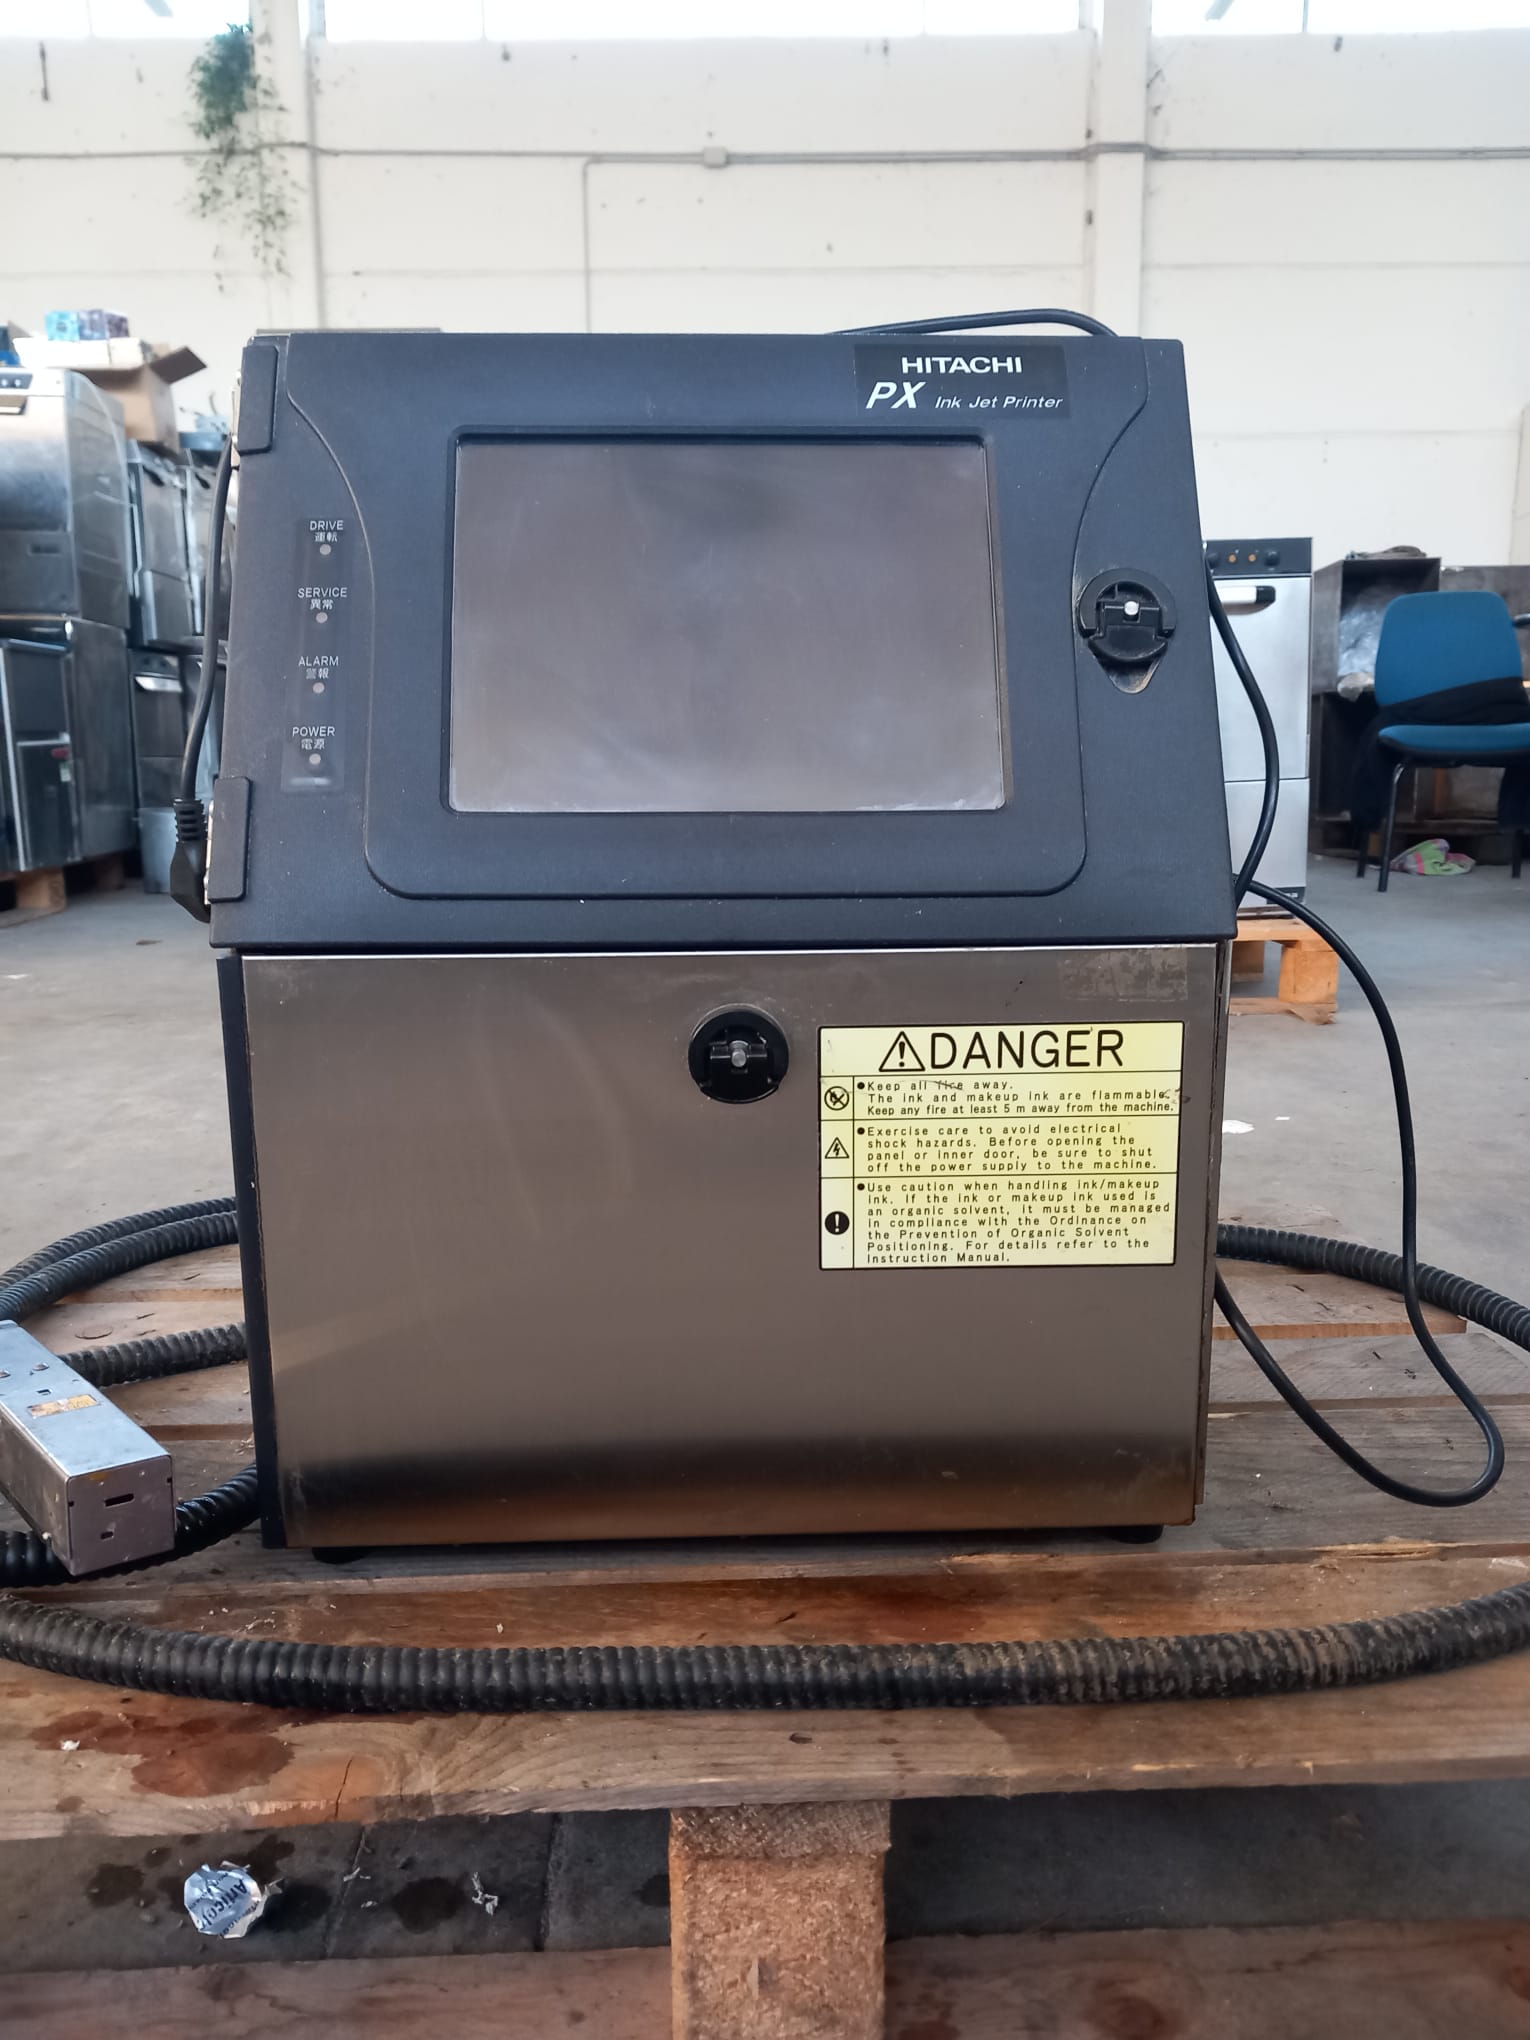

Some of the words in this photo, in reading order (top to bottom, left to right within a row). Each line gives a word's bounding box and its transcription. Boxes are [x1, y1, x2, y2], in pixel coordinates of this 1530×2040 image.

[901, 356, 1023, 374] HITACHI
[865, 381, 927, 409] PX
[935, 396, 962, 409] Ink
[969, 396, 998, 409] Jet
[1003, 396, 1064, 409] Printer
[309, 520, 344, 531] DRIVE
[297, 587, 348, 598] SERVICE
[298, 655, 339, 667] ALARM
[292, 726, 335, 737] POWER
[930, 1029, 1125, 1070] DANGER
[867, 1081, 901, 1092] Keep
[911, 1080, 931, 1091] all
[974, 1081, 1013, 1091] away.
[868, 1093, 893, 1104] The
[903, 1093, 924, 1104] ink
[933, 1092, 957, 1103] and
[967, 1091, 1019, 1103] makeup
[1029, 1091, 1049, 1102] ink
[1059, 1093, 1082, 1101] are
[868, 1106, 895, 1117] Keep
[901, 1107, 921, 1117] any
[927, 1104, 947, 1115] fire
[953, 1105, 965, 1115] at
[970, 1104, 998, 1115] least
[1004, 1103, 1011, 1114] 5
[1016, 1106, 1026, 1114] m
[1032, 1105, 1061, 1114] away
[1067, 1103, 1094, 1113] from
[1099, 1102, 1118, 1113] the
[1124, 1101, 1174, 1112] machine.
[867, 1126, 929, 1137] Exercise
[938, 1128, 969, 1136] care
[979, 1126, 993, 1135] to
[1003, 1124, 1040, 1135] avoid
[1050, 1123, 1121, 1135] electrical
[868, 1138, 907, 1150] shock
[917, 1137, 977, 1149] hazards.
[989, 1136, 1038, 1148] Before
[1047, 1136, 1103, 1148] opening
[1113, 1135, 1135, 1146] the
[868, 1150, 905, 1162] panel
[914, 1152, 929, 1161] or
[938, 1149, 974, 1161] inner
[1033, 1148, 1048, 1159] be
[1058, 1150, 1088, 1158] sure
[1098, 1148, 1112, 1158] to
[1122, 1147, 1153, 1158] shut
[868, 1162, 889, 1173] off
[899, 1162, 921, 1173] the
[931, 1163, 973, 1173] power
[983, 1160, 1028, 1173] supply
[1038, 1161, 1052, 1171] to
[1062, 1160, 1084, 1170] the
[1094, 1159, 1157, 1170] machine.
[867, 1182, 892, 1193] Use
[901, 1181, 954, 1192] caution
[964, 1181, 998, 1192] when
[1008, 1180, 1068, 1192] handling
[1078, 1179, 1160, 1191] ink/makeup
[869, 1194, 894, 1205] ink.
[906, 1193, 916, 1205] If
[927, 1193, 949, 1204] the
[959, 1193, 979, 1204] ink
[988, 1195, 1002, 1203] or
[1012, 1192, 1064, 1204] makeup
[1074, 1192, 1094, 1202] ink
[1104, 1191, 1135, 1202] used
[1145, 1191, 1156, 1201] is
[868, 1209, 883, 1217] an
[892, 1205, 944, 1217] organic
[1023, 1204, 1033, 1215] it
[1043, 1204, 1076, 1215] must
[1086, 1203, 1101, 1214] be
[1110, 1202, 1170, 1214] managed
[869, 1218, 880, 1229] in
[890, 1217, 968, 1229] compliance
[978, 1216, 1008, 1227] with
[1018, 1216, 1040, 1227] the
[1050, 1215, 1122, 1226] Ordinance
[1131, 1217, 1147, 1225] on
[868, 1230, 890, 1241] the
[900, 1229, 978, 1240] Prevention
[987, 1228, 1001, 1239] of
[1011, 1227, 1066, 1239] Organic
[1075, 1225, 1129, 1238] Solvent
[868, 1241, 954, 1253] Positioning.
[966, 1241, 989, 1251] For
[999, 1240, 1047, 1250] details
[1057, 1239, 1094, 1249] refer
[1104, 1240, 1118, 1249] to
[1128, 1238, 1150, 1249] the
[868, 1253, 947, 1265] Instruction
[957, 1252, 1010, 1263] Manual.
